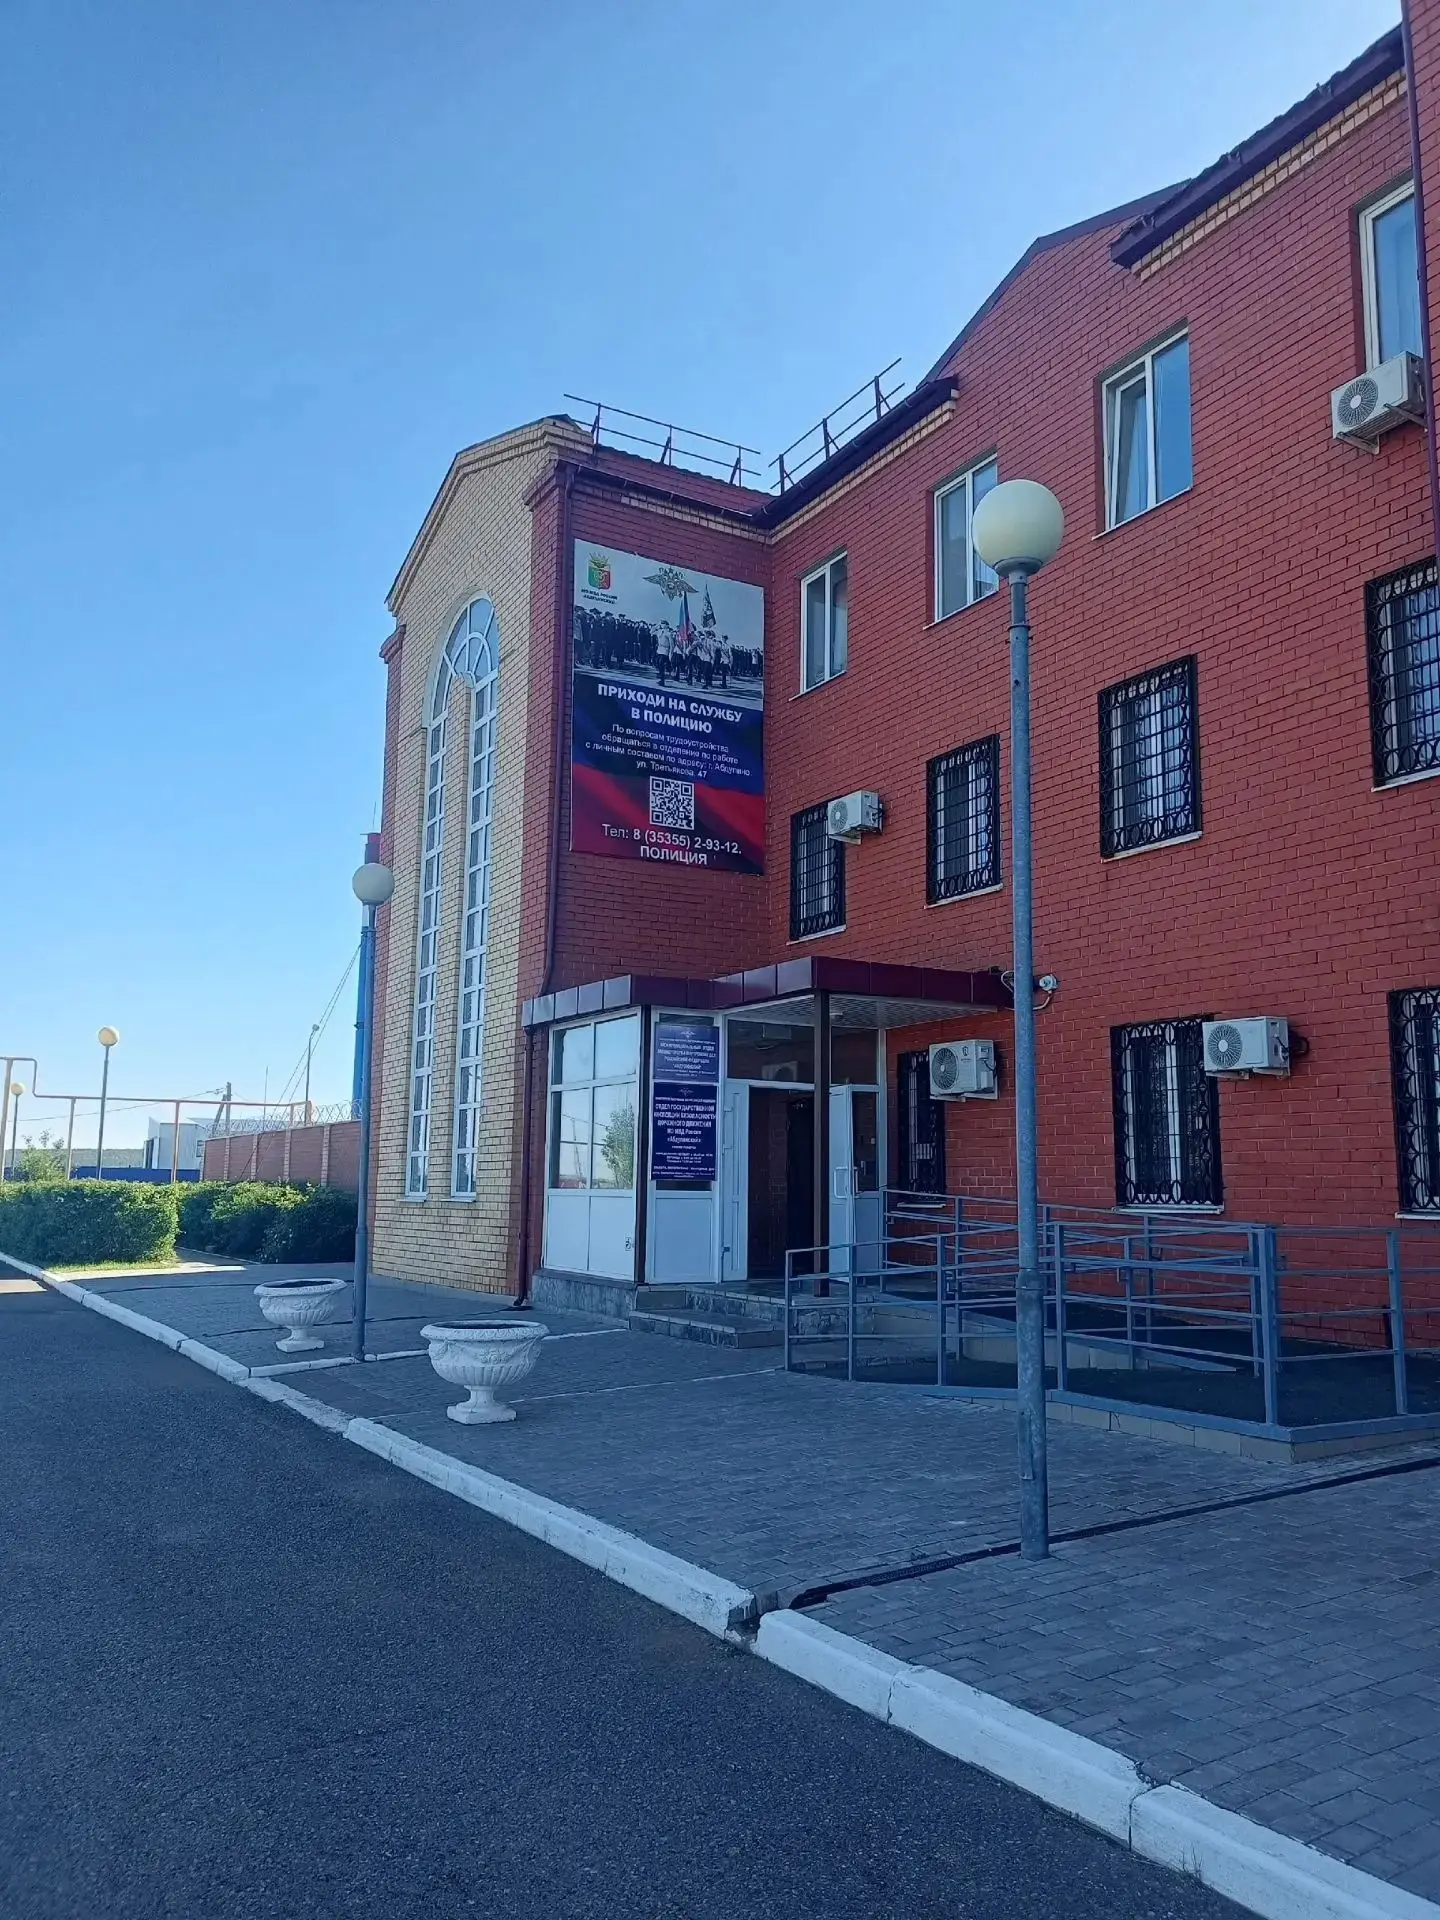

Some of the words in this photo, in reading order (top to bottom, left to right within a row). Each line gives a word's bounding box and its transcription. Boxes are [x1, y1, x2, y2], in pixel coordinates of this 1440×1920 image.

[598, 684, 665, 708] ПРИХОДИ
[669, 698, 686, 711] НА
[691, 702, 742, 723] СЛУЖБУ
[631, 708, 640, 719] В
[644, 710, 712, 734] ПОЛИЦИЮ
[593, 743, 625, 755] личным
[628, 748, 665, 761] составом
[602, 733, 651, 748] обращаться
[713, 753, 738, 764] работе
[612, 724, 624, 733] По
[626, 728, 664, 740] вопросам
[667, 736, 728, 752] трудоустройства
[602, 824, 629, 839] Тел:
[633, 828, 641, 840] 8
[645, 829, 690, 849] (35355)
[694, 837, 742, 854] 2-93-12.
[640, 845, 707, 864] ПОЛИЦИЯ
